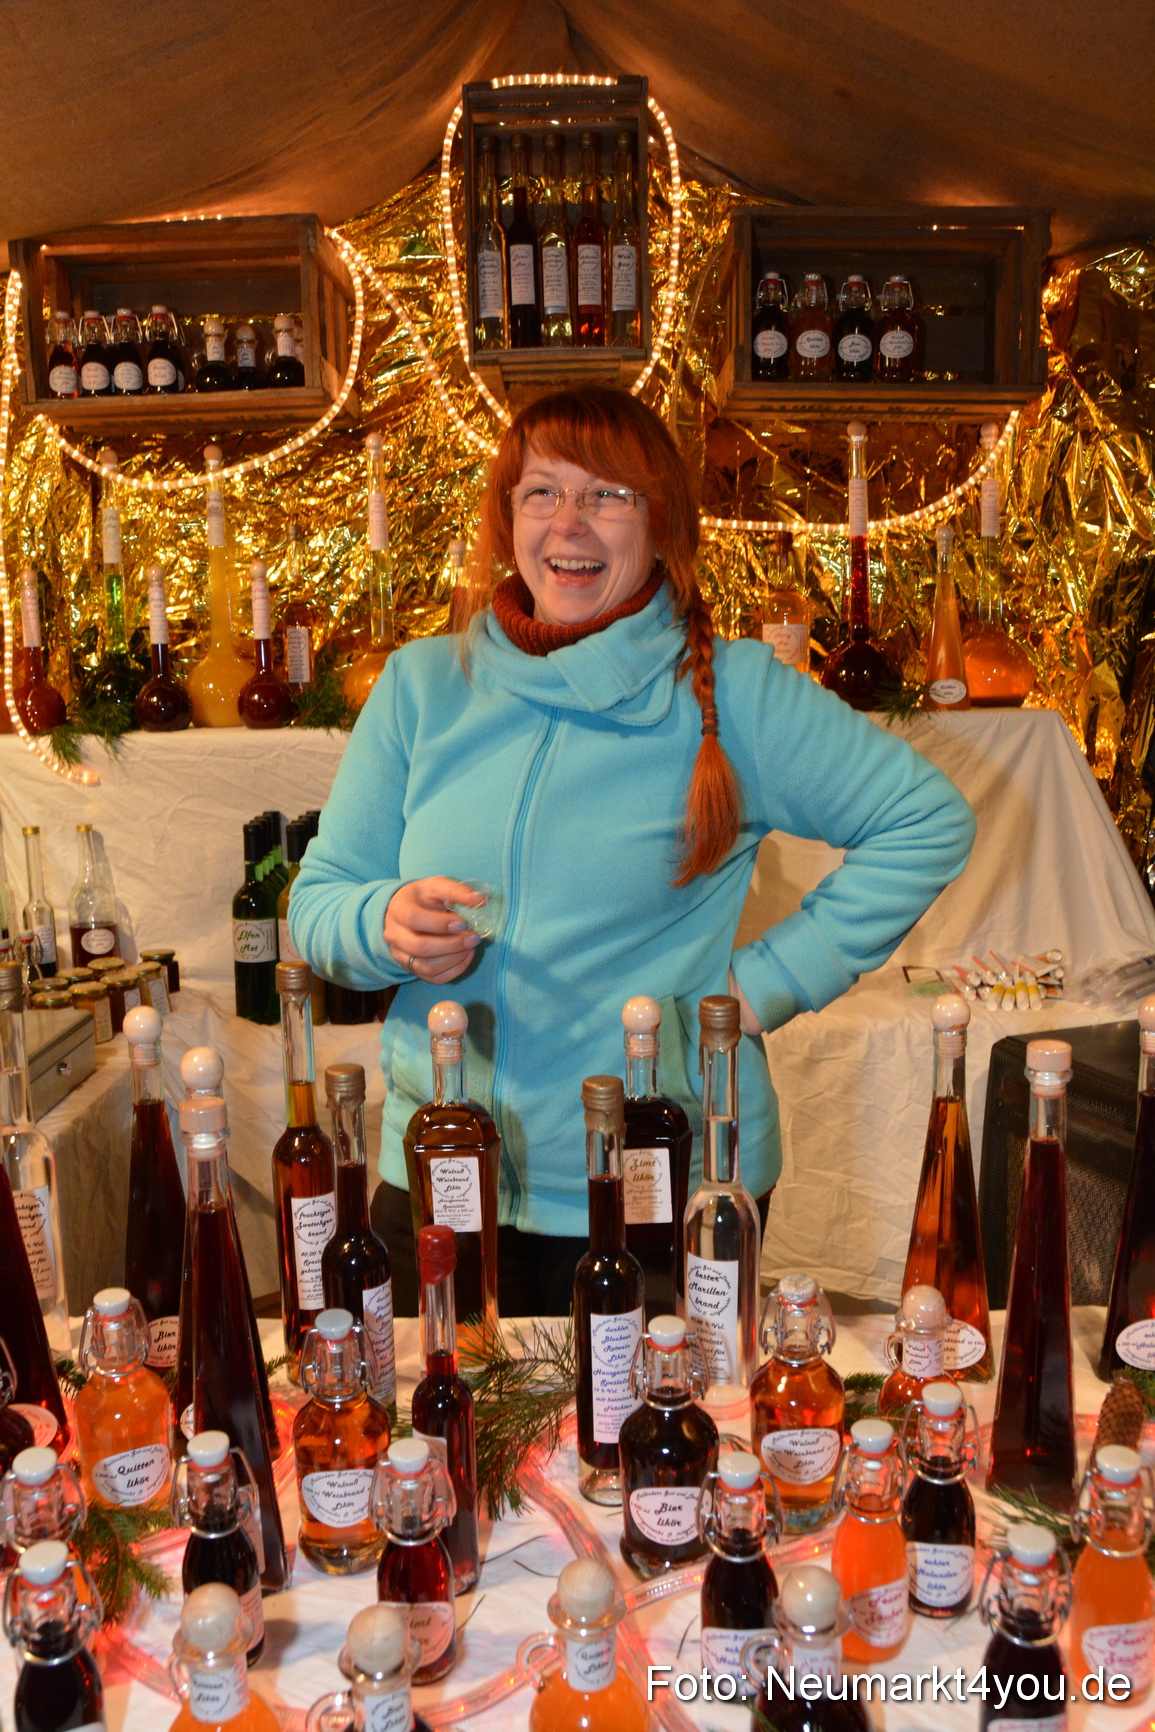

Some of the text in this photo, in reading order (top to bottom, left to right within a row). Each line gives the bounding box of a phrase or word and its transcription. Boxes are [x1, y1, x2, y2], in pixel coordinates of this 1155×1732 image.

[237, 930, 260, 941] Elfen
[240, 943, 258, 953] Met
[630, 1159, 656, 1171] Zimt
[308, 1228, 327, 1238] brand
[695, 1269, 720, 1283] bester
[694, 1296, 720, 1309] brand
[154, 1331, 176, 1343] Bier
[601, 1334, 631, 1344] Blaubeer
[604, 1344, 630, 1352] Rotwein
[608, 1354, 627, 1363] Likör
[789, 1438, 820, 1447] Walnuß
[784, 1446, 825, 1456] Weinbrand
[118, 1459, 155, 1475] Quitten
[126, 1476, 150, 1488] likör
[327, 1478, 359, 1488] Walnuß
[322, 1487, 365, 1498] Weinbrand
[332, 1501, 354, 1511] Likör
[654, 1502, 683, 1514] Bier
[657, 1517, 682, 1526] likör
